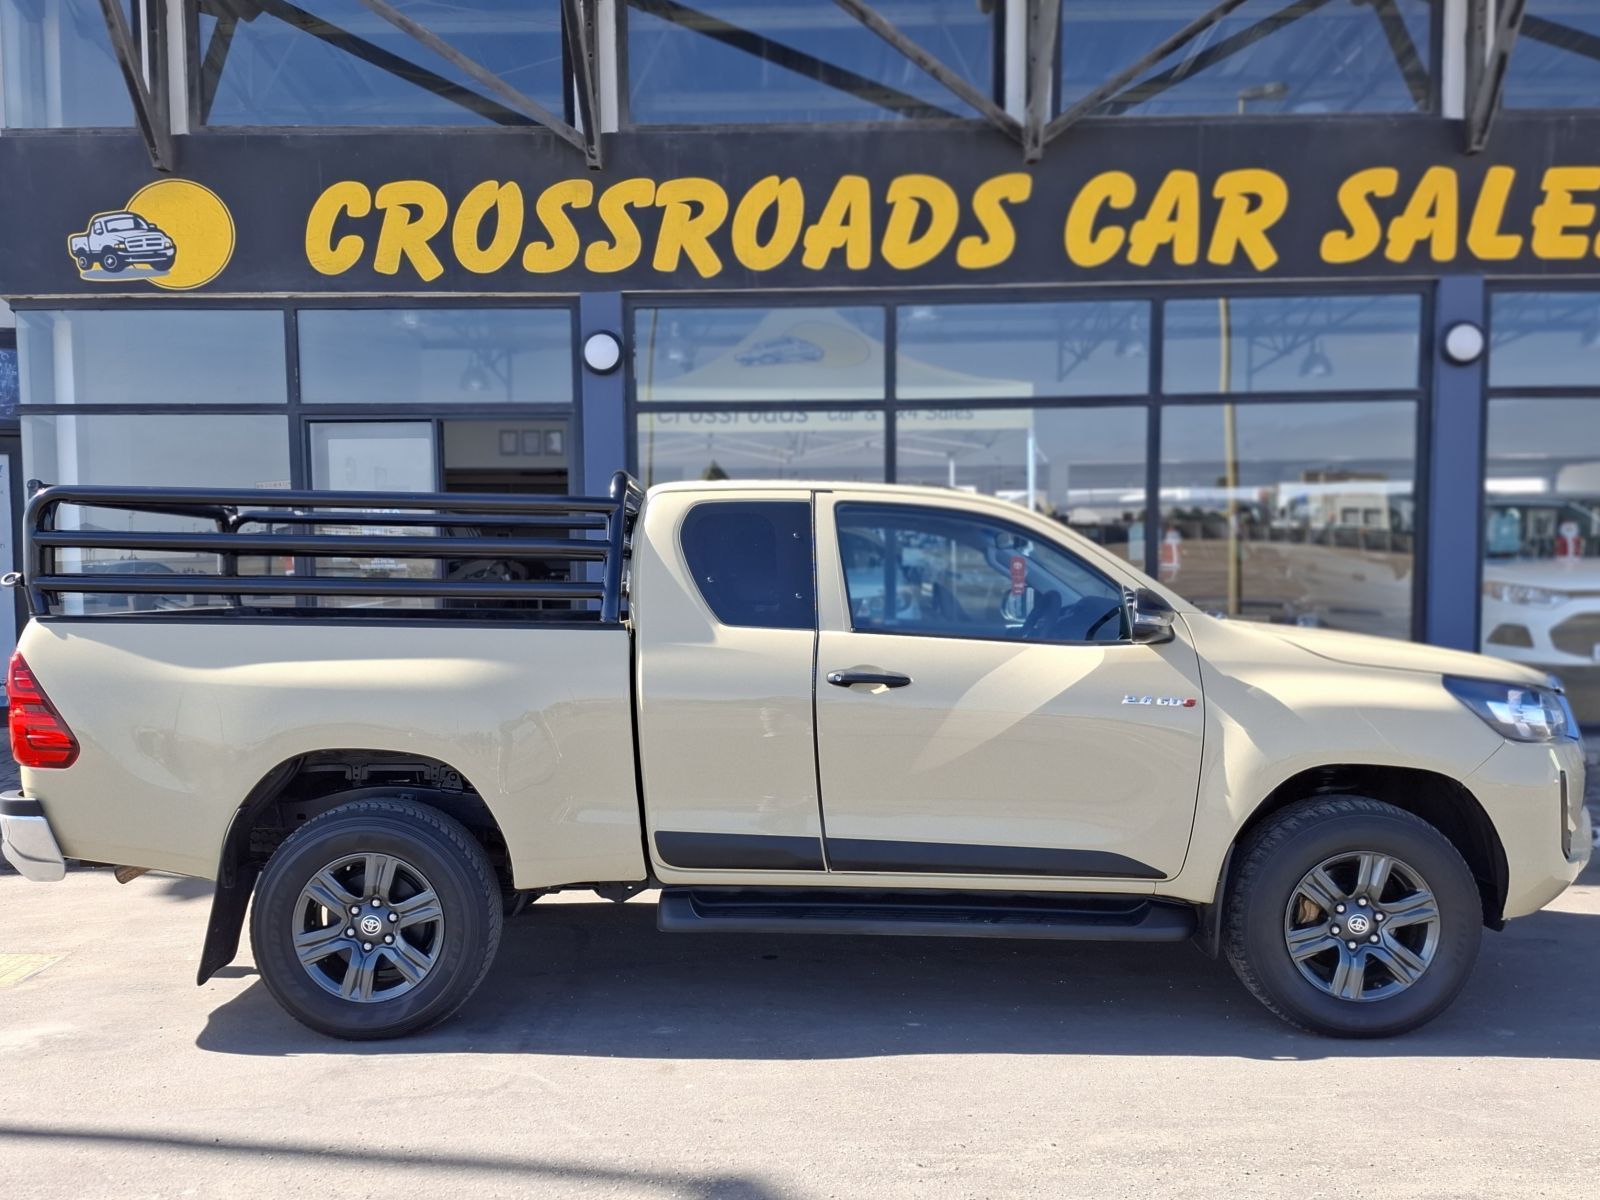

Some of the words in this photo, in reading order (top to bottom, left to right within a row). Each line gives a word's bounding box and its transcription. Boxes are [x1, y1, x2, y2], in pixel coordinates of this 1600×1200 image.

[306, 174, 1032, 281] CROSSROADS
[1064, 168, 1289, 271] CAR
[1319, 165, 1600, 264] SALE
